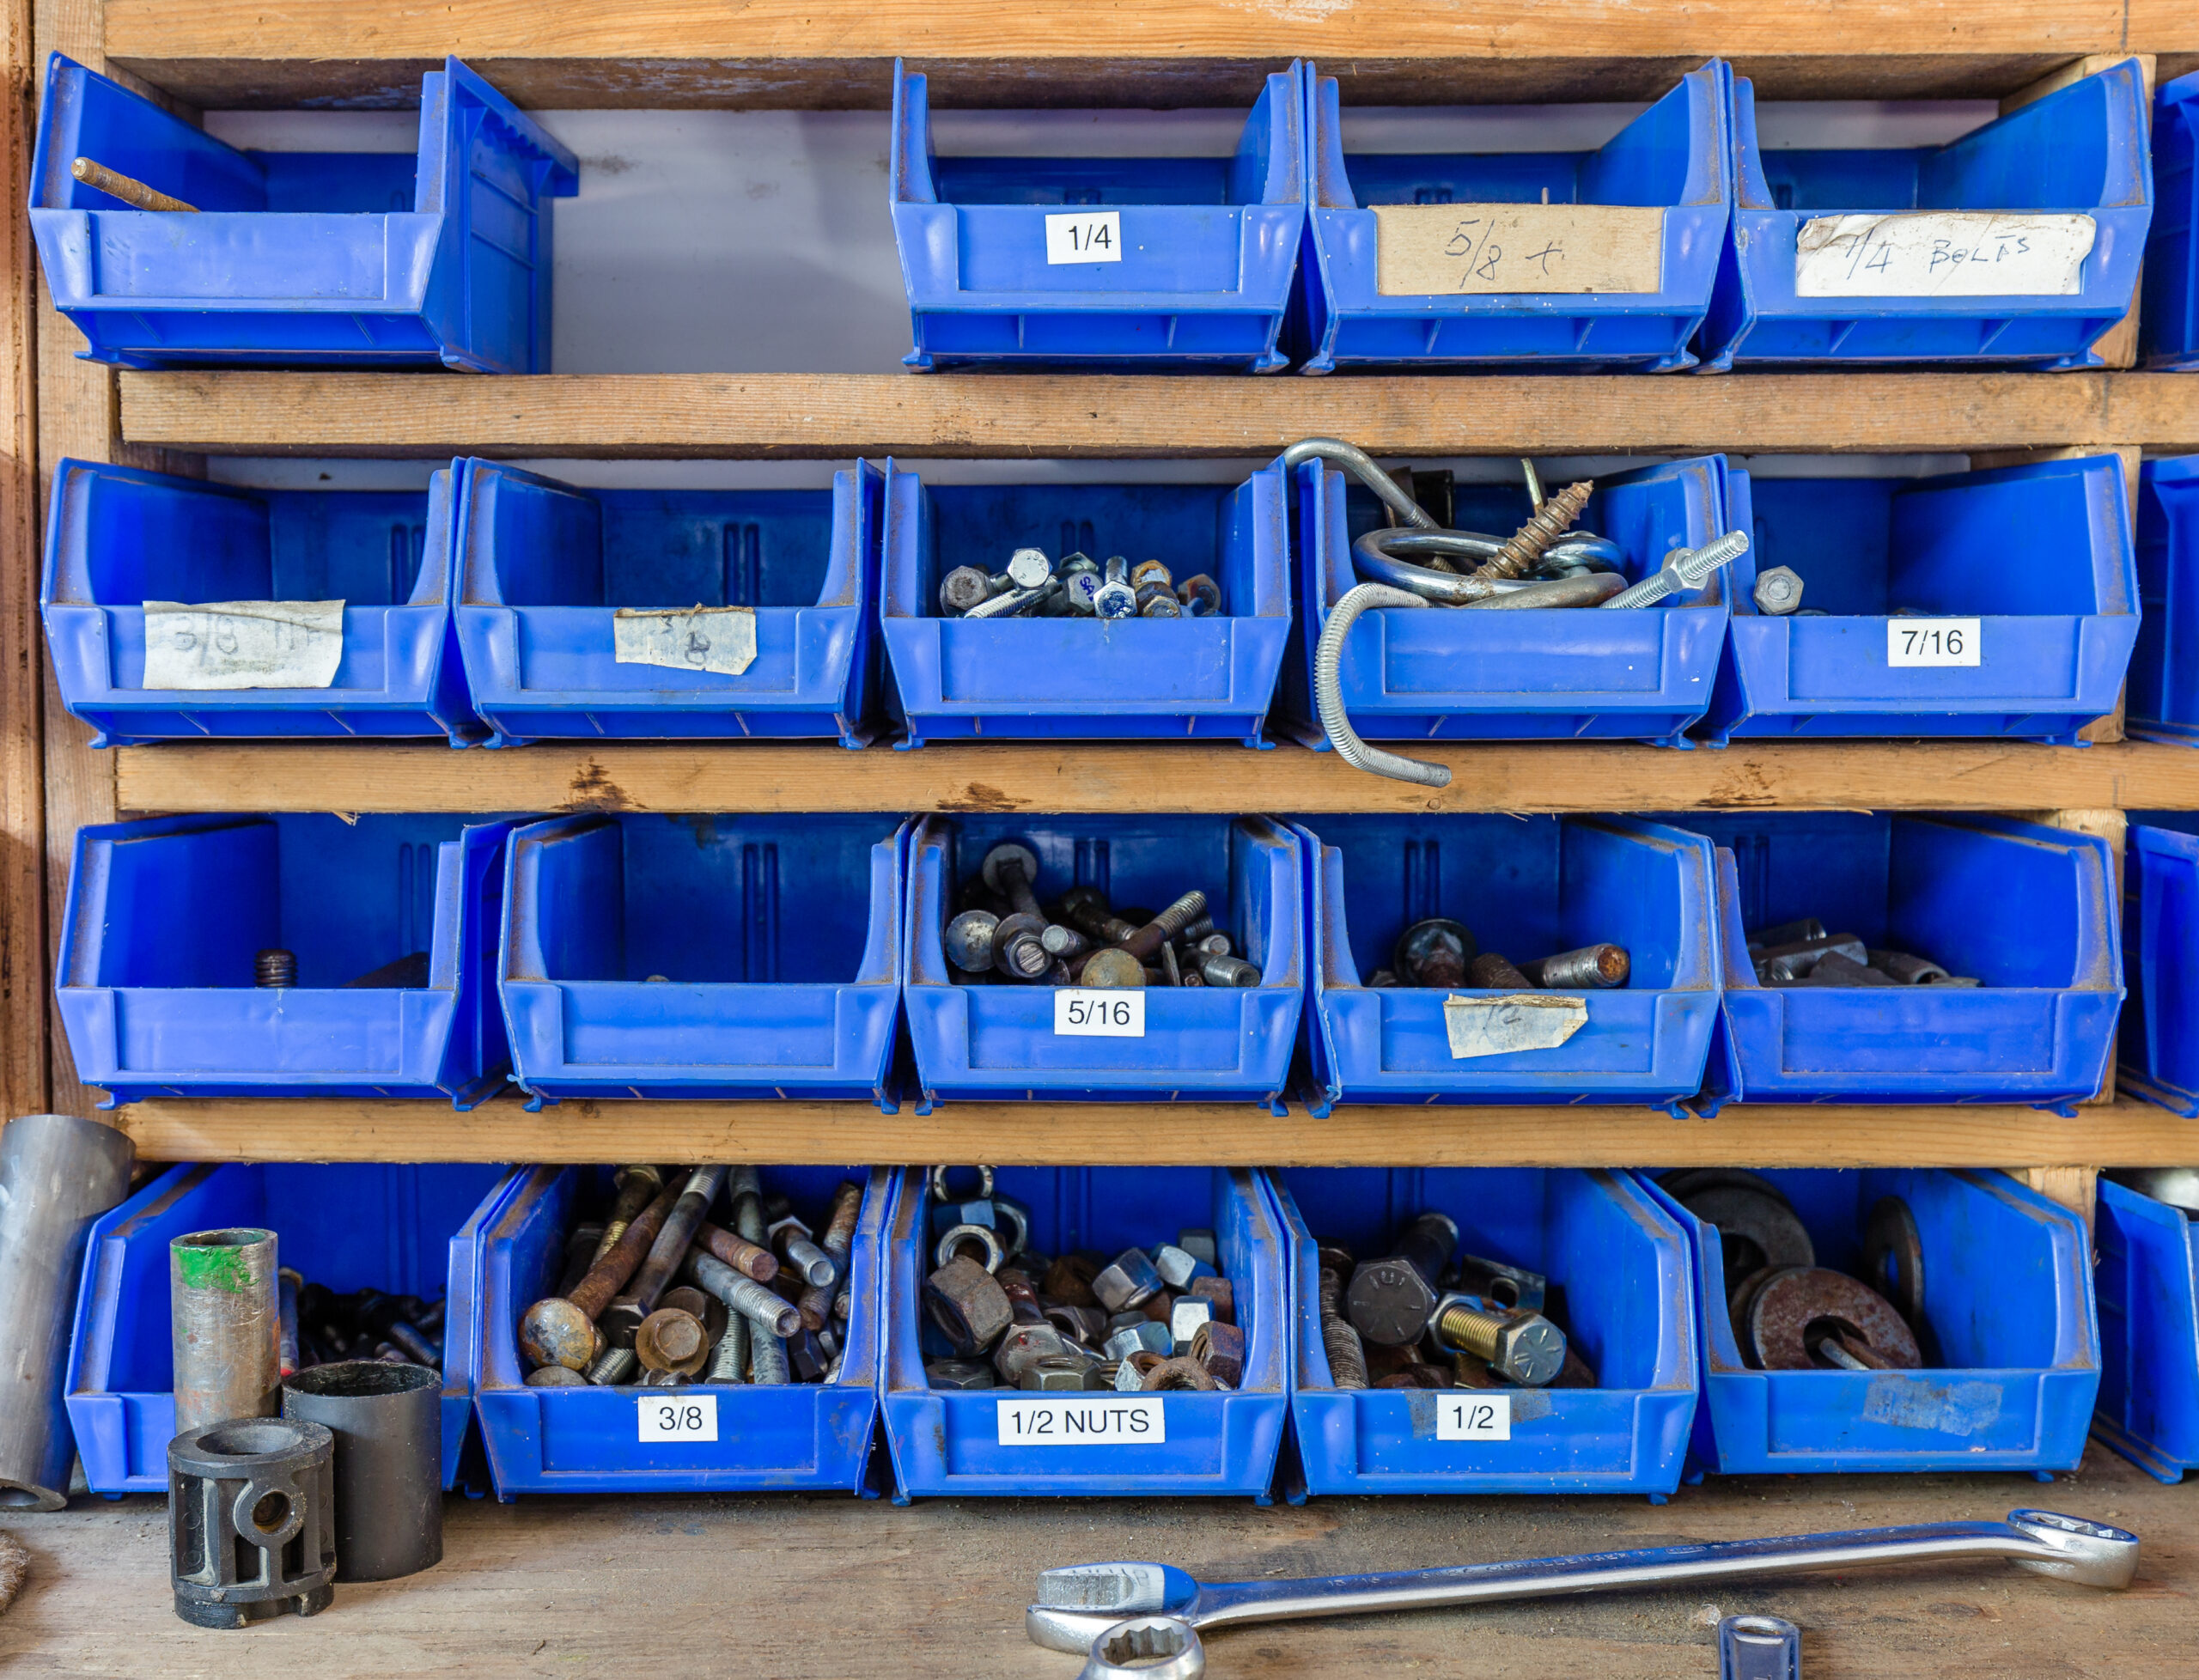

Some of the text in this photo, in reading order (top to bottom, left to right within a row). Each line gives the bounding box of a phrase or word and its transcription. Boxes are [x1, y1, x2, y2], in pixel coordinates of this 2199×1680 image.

[1068, 223, 1112, 251] 1/4
[1444, 218, 1502, 290] 5/8
[1901, 629, 1964, 655] 7/16
[1068, 1000, 1130, 1026] 5/16
[659, 1405, 704, 1431] 3/8
[1011, 1409, 1150, 1434] 1/2 NUTS
[1453, 1404, 1495, 1430] 1/2
